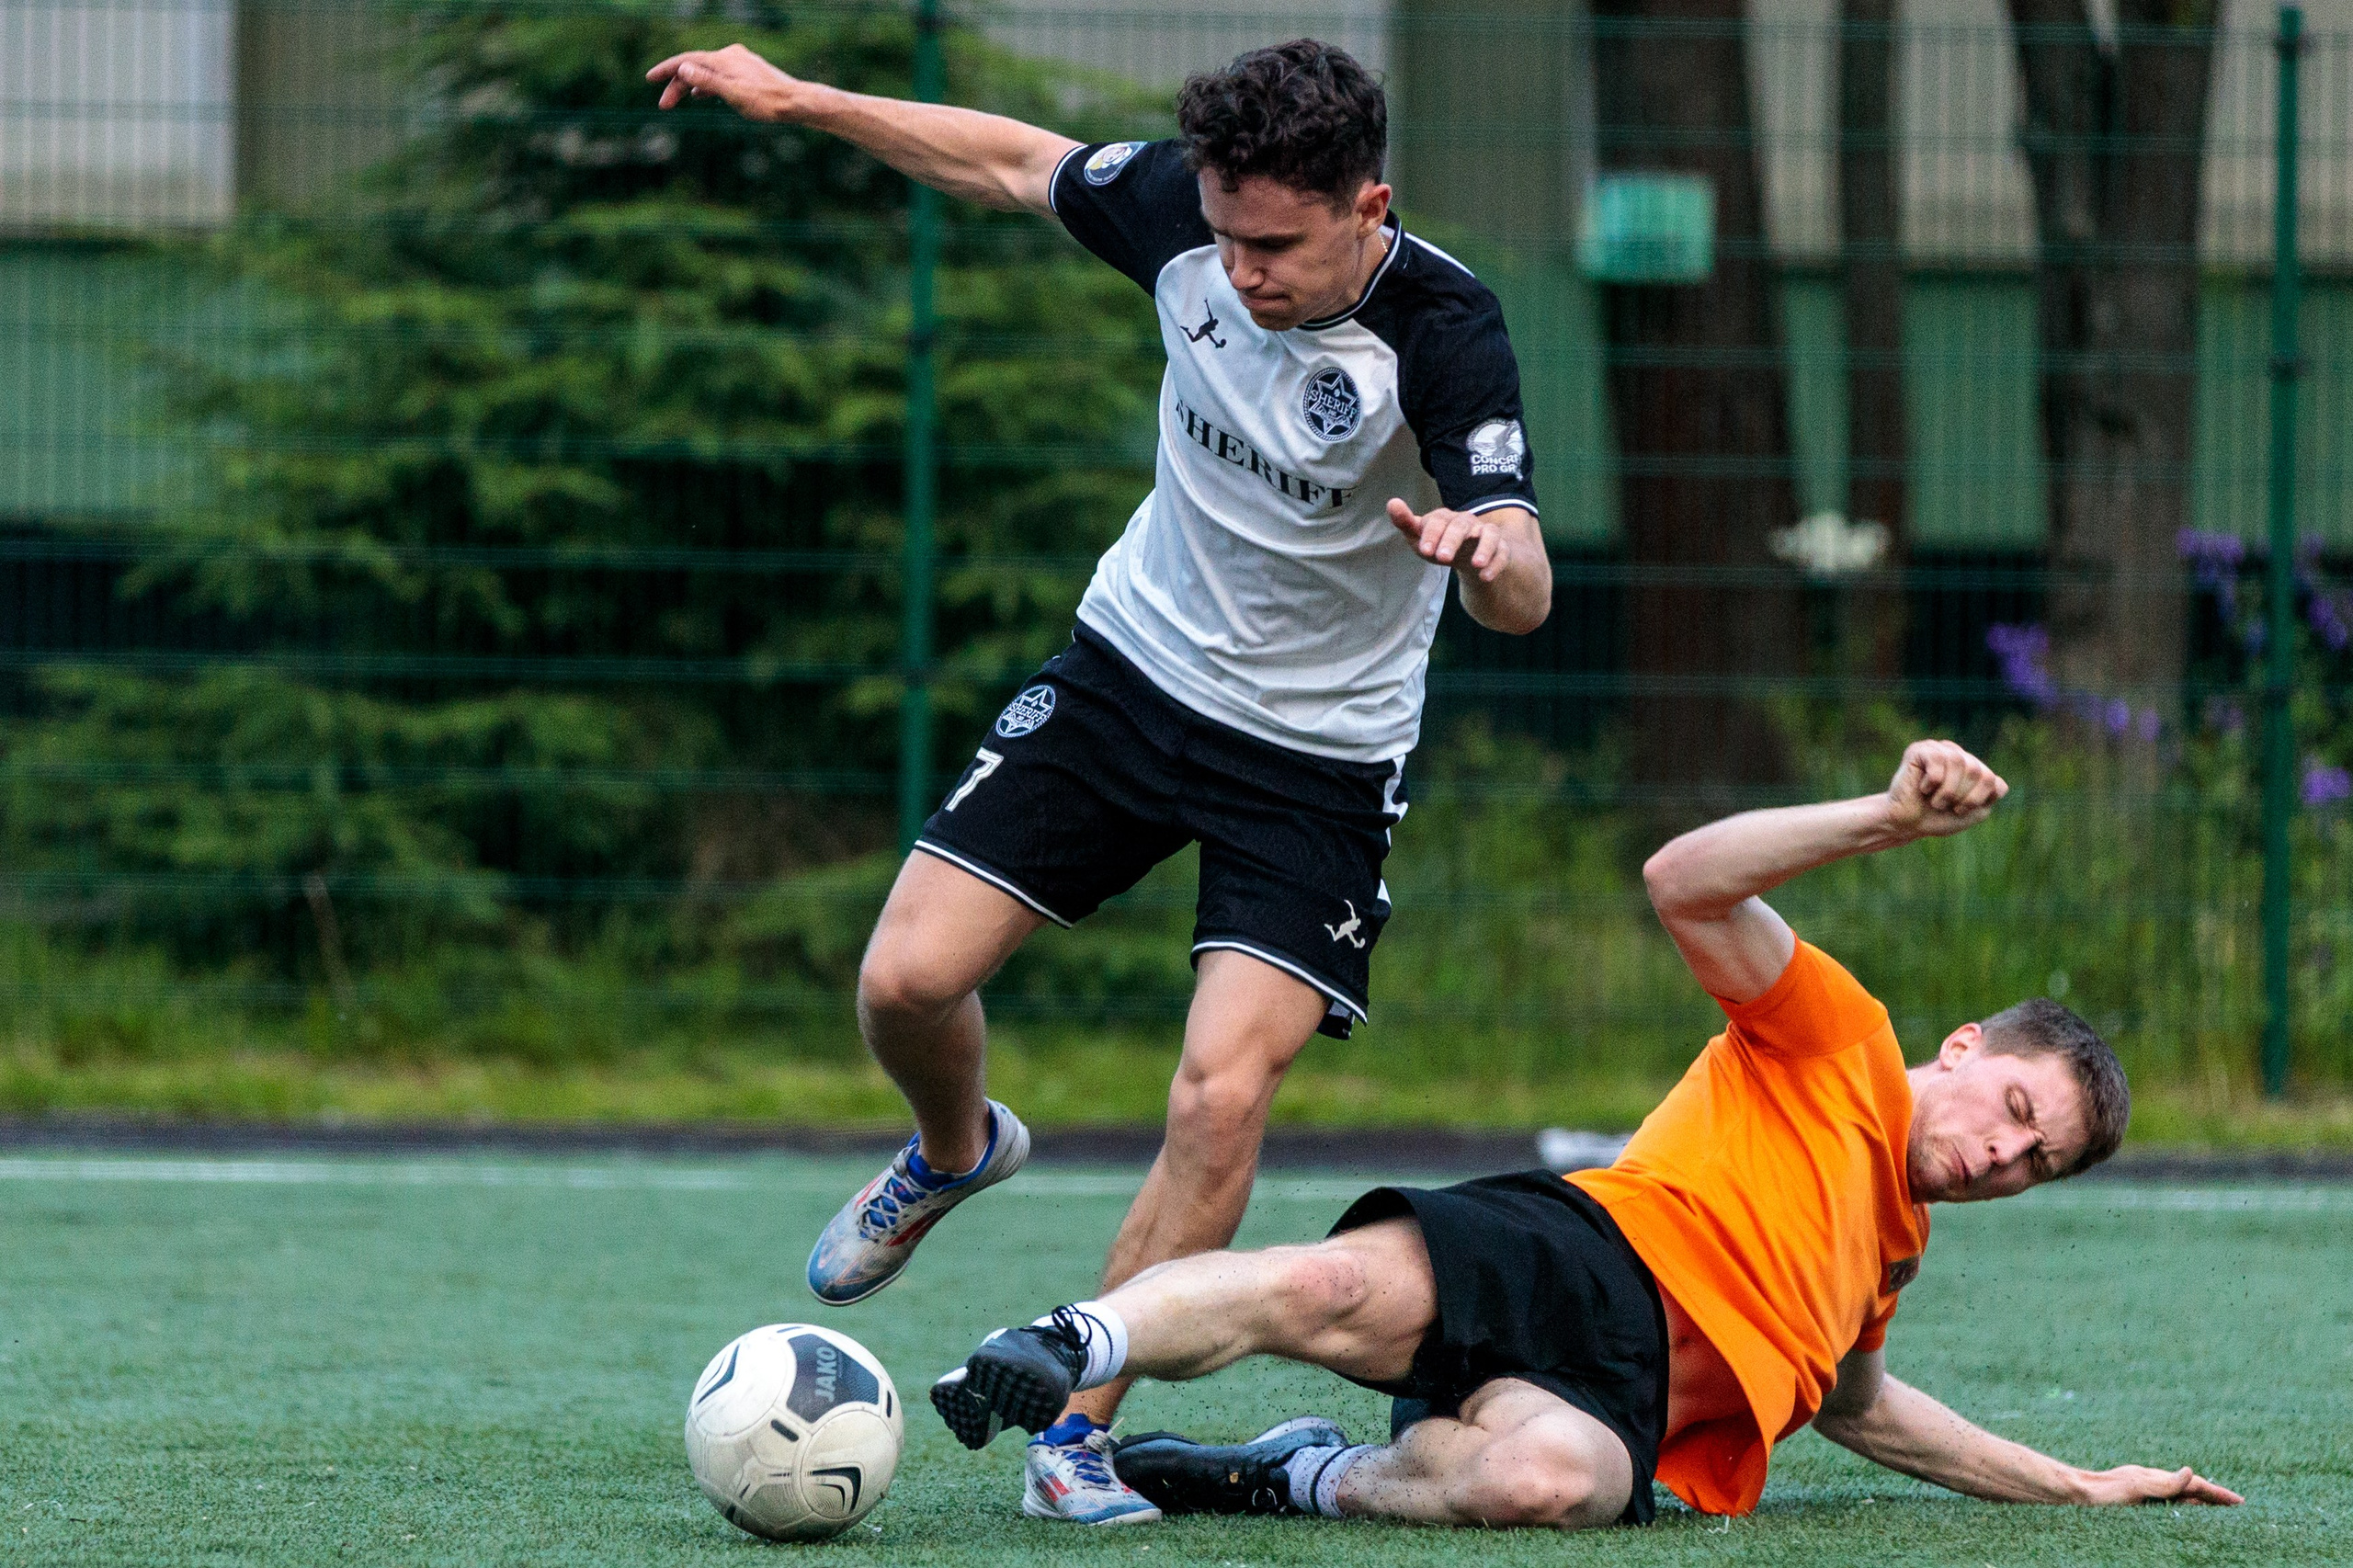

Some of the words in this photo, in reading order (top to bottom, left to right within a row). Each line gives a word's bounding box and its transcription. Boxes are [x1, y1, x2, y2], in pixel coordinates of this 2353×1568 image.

[1309, 389, 1358, 418] SHERIFF
[1472, 464, 1497, 475] PRO
[1499, 463, 1517, 473] GR
[945, 746, 1004, 812] 7
[814, 1346, 836, 1403] JAKO
